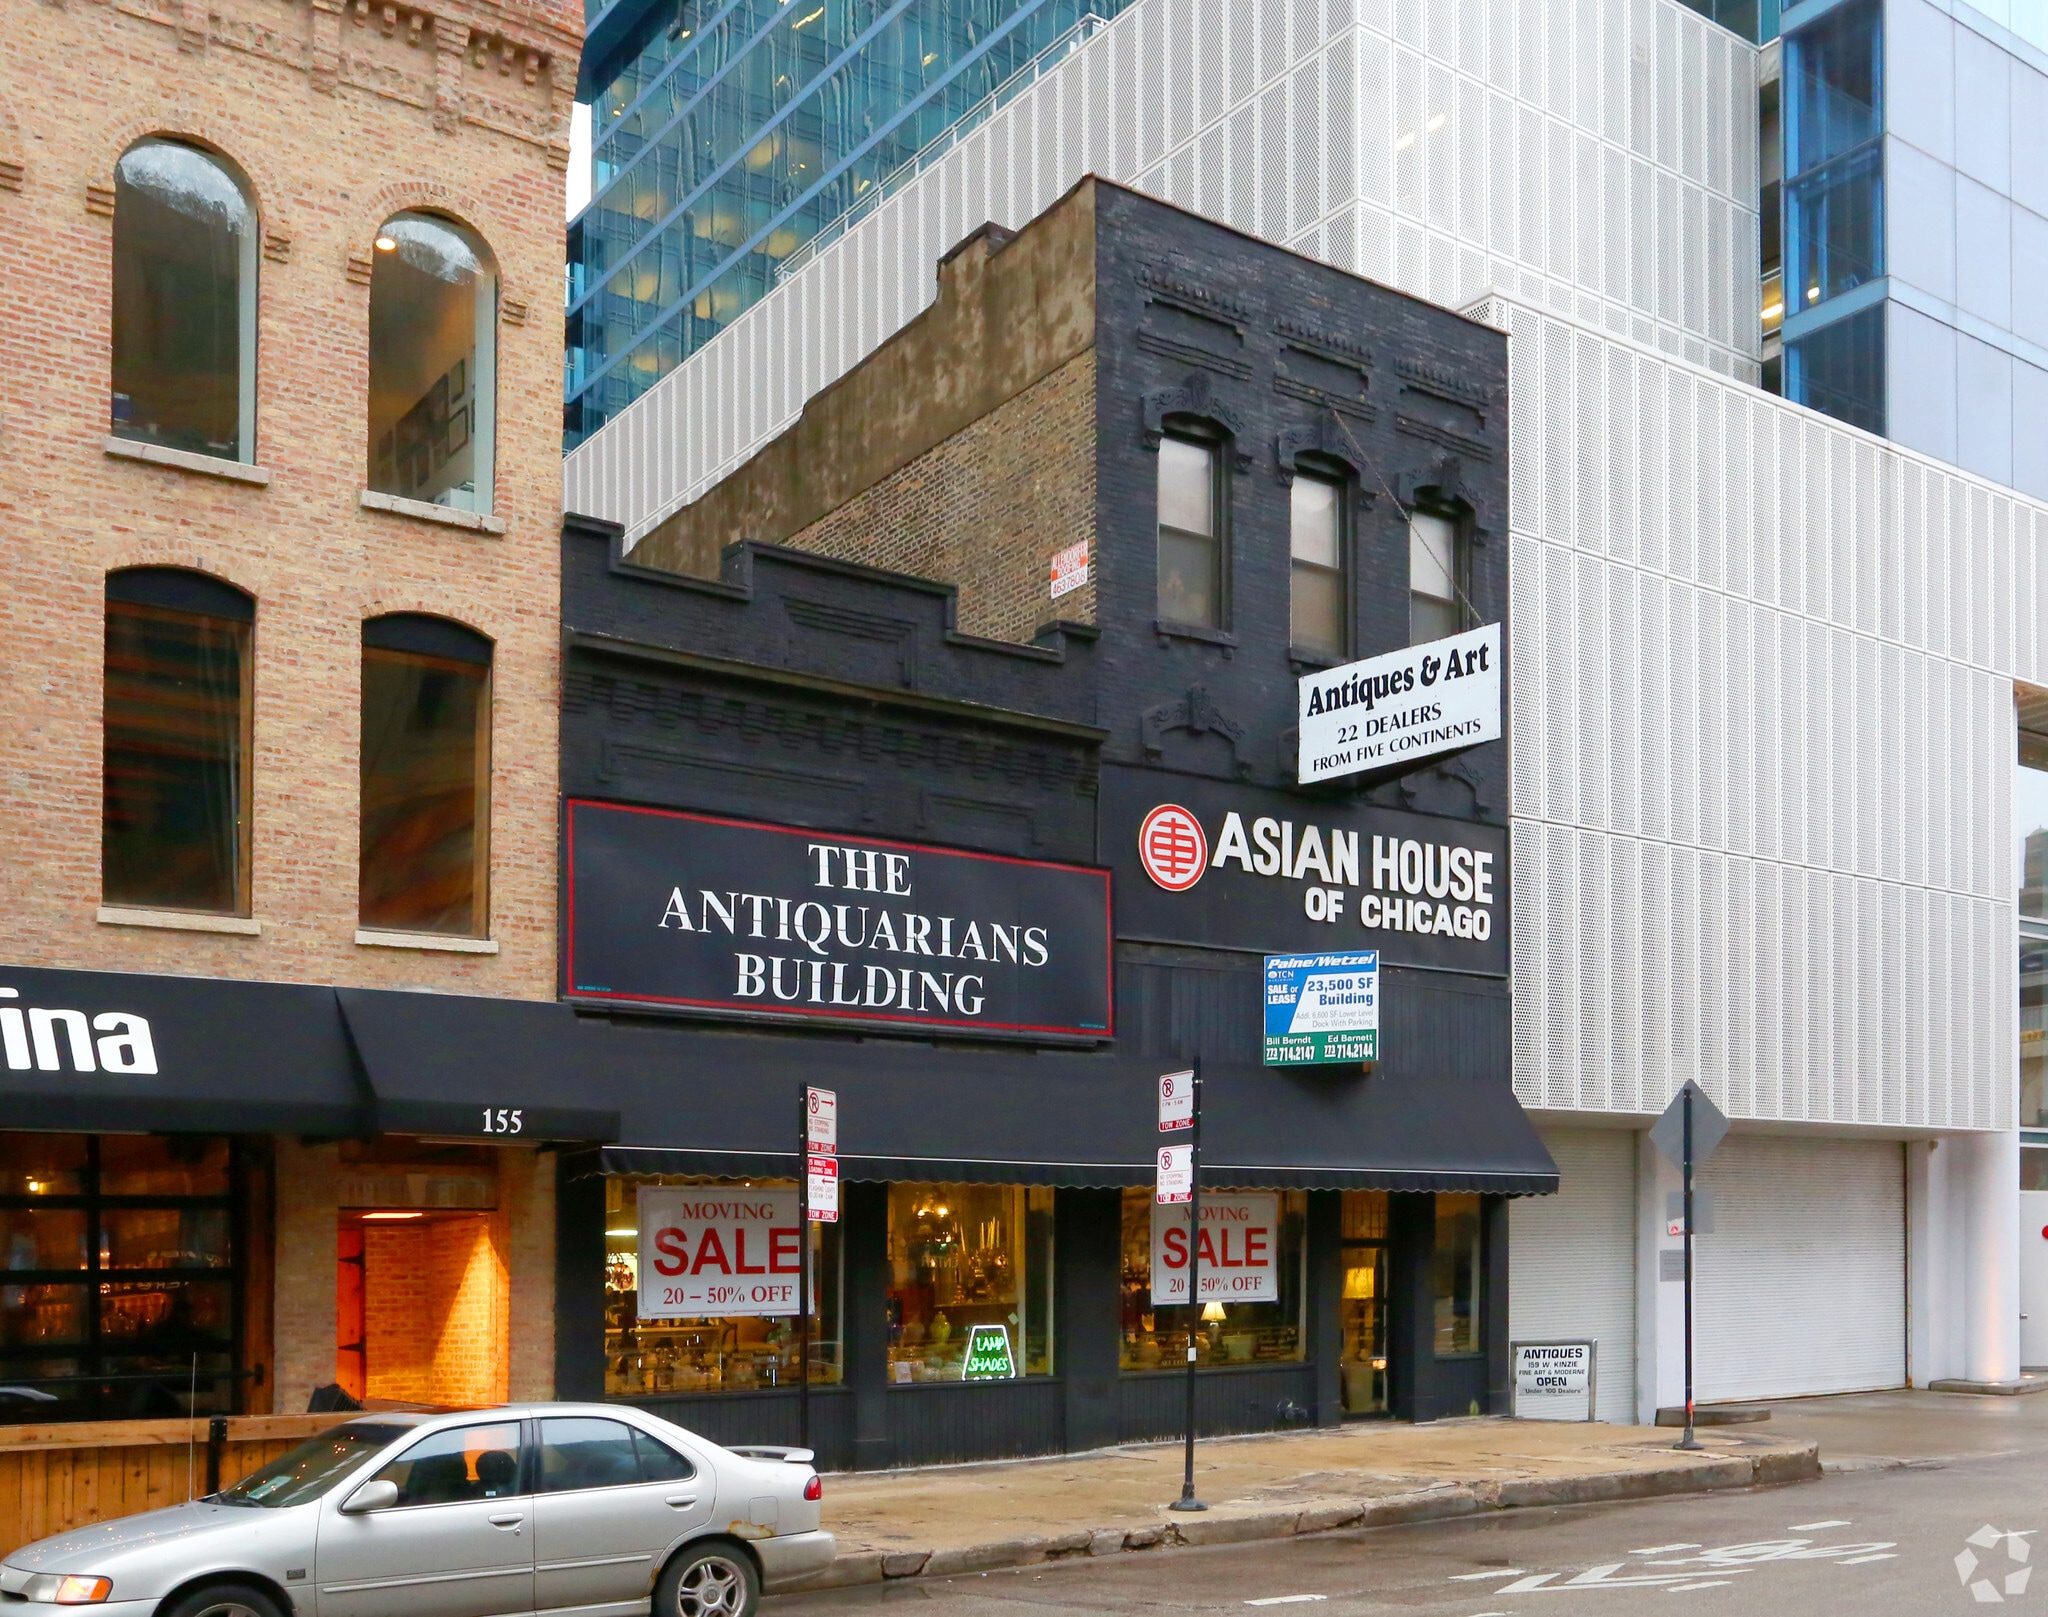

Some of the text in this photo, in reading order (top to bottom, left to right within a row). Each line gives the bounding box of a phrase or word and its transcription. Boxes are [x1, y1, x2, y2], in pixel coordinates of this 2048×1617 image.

[1307, 643, 1489, 717] Antiques & Art
[1337, 702, 1442, 745] 22 DEALERS
[1313, 718, 1481, 772] FROM FIVE CONTINENTS
[1211, 811, 1494, 904] ASIAN HOUSE
[808, 843, 913, 898] THE
[1305, 886, 1492, 941] OF CHICAGO
[657, 886, 1050, 967] ANTIQUARIANS
[1267, 953, 1376, 970] Paine/Wetzel
[1277, 970, 1294, 979] TCN
[733, 952, 986, 1016] BUILDING
[1267, 984, 1288, 994] SALE
[1307, 977, 1374, 993] 23,500 SF
[1267, 994, 1297, 1004] LEASE
[1319, 993, 1374, 1007] Building
[1358, 1009, 1374, 1017] Level
[0, 987, 159, 1075] ina
[1312, 1018, 1373, 1028] Dock With Parking
[1266, 1036, 1311, 1045] Bill Berndt
[1328, 1034, 1373, 1043] Ed Barnett
[483, 1108, 522, 1134] 155
[1161, 1119, 1190, 1130] TOW ZONE
[808, 1141, 833, 1153] TOW ZONE
[1174, 1192, 1188, 1201] ZONE
[682, 1202, 774, 1220] MOVING
[808, 1210, 835, 1220] TOW ZONE
[1183, 1206, 1249, 1221] MOVING
[653, 1227, 801, 1276] SALE
[1162, 1227, 1269, 1269] SALE
[1169, 1276, 1262, 1293] 20 50% OFF
[663, 1287, 684, 1304] 20
[707, 1286, 745, 1304] 50%
[751, 1285, 793, 1303] OFF
[976, 1336, 1005, 1352] LAMP
[1523, 1348, 1583, 1359] ANTIQUES
[968, 1357, 1009, 1372] SHADES
[1536, 1377, 1567, 1386] OPEN
